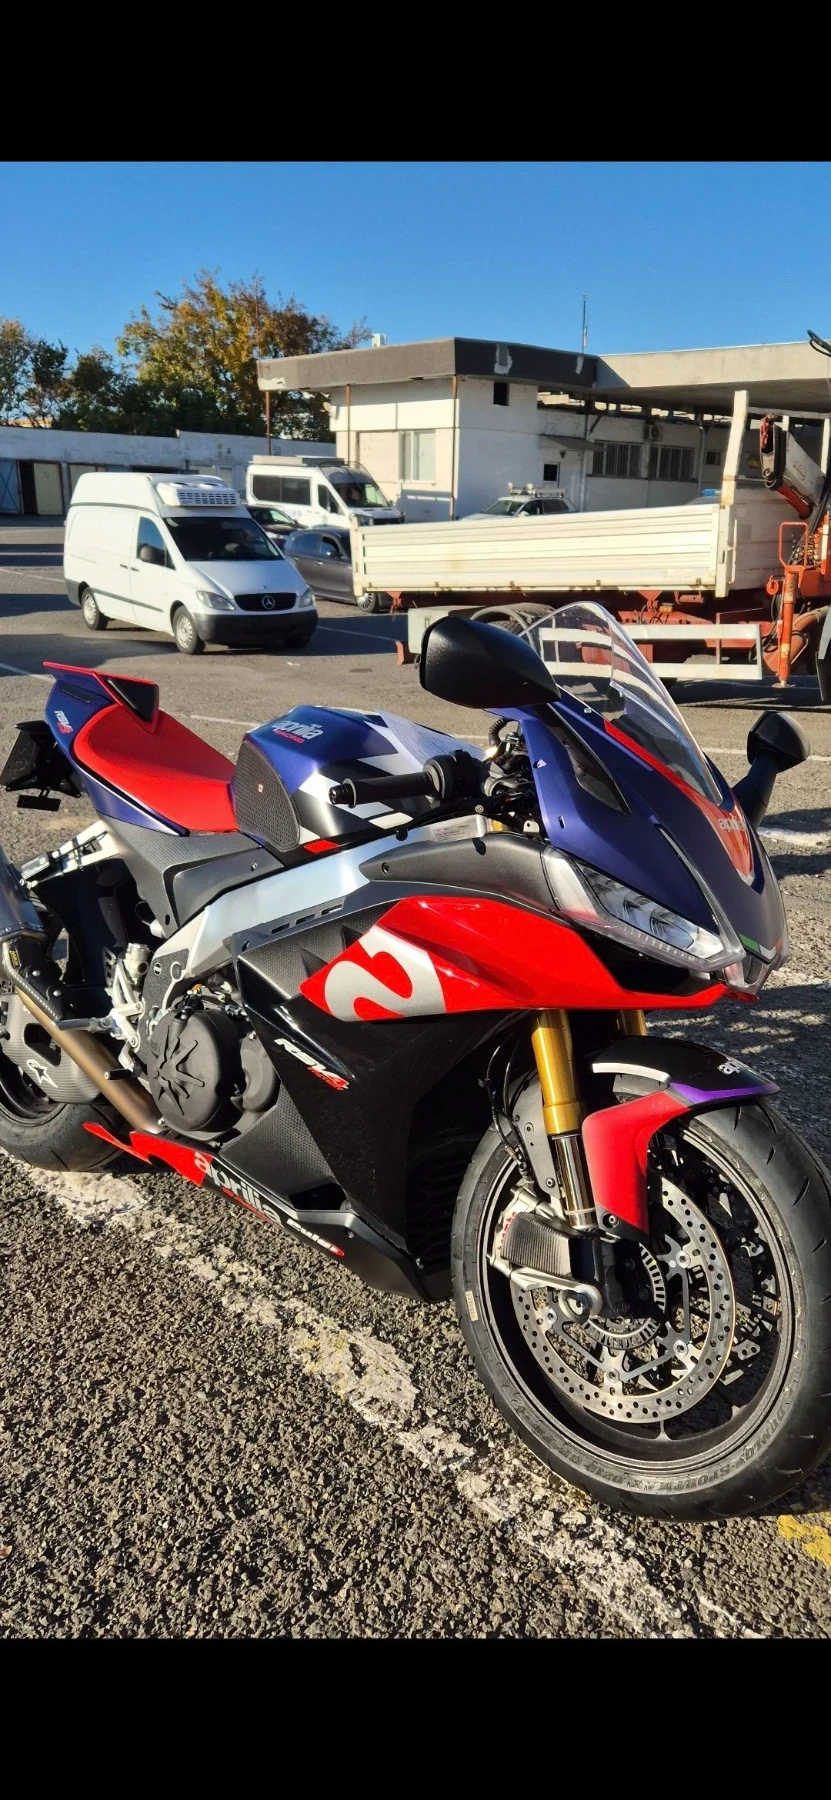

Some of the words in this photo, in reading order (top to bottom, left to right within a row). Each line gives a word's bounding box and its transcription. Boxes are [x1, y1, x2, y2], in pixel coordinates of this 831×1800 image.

[271, 720, 324, 740] aprilia
[273, 1038, 350, 1089] RSV4
[194, 1152, 285, 1229] aprilia
